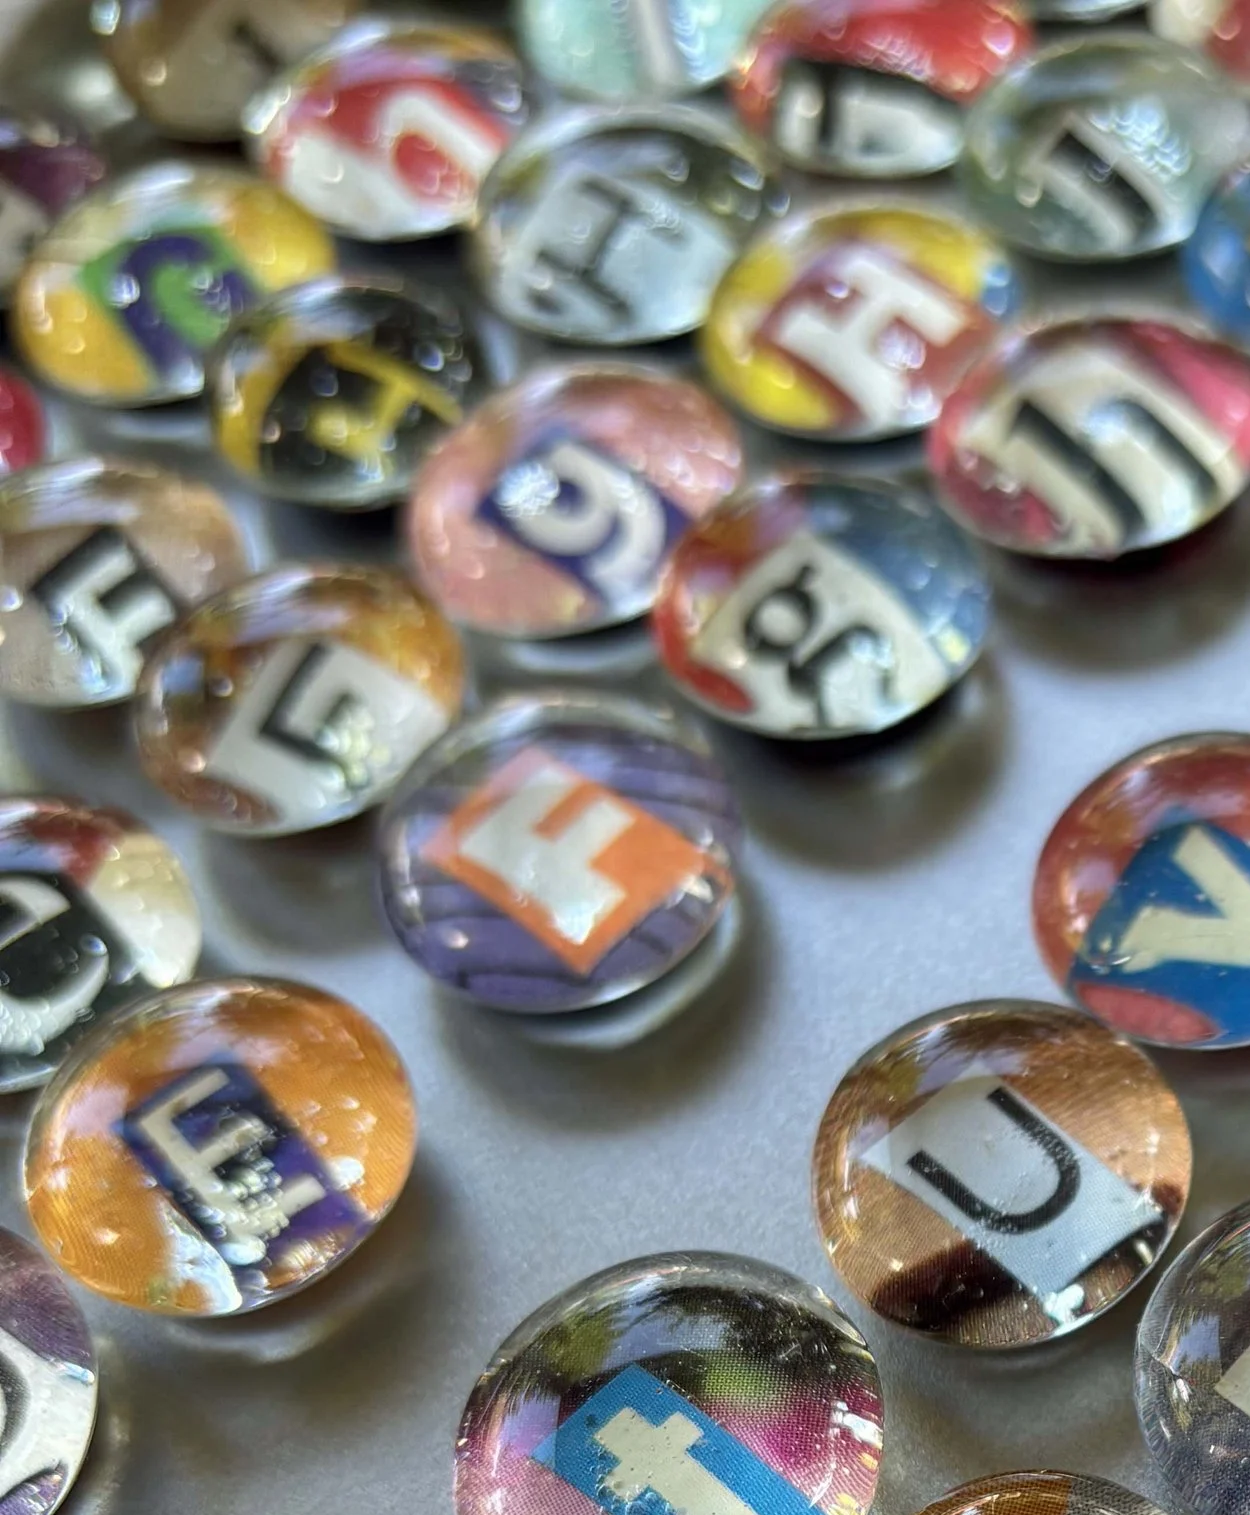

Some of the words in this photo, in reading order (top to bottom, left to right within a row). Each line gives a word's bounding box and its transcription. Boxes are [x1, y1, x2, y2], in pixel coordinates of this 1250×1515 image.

[778, 249, 967, 424] H
[458, 762, 638, 945] F
[139, 1067, 327, 1240] E
[904, 1085, 1083, 1234] U
